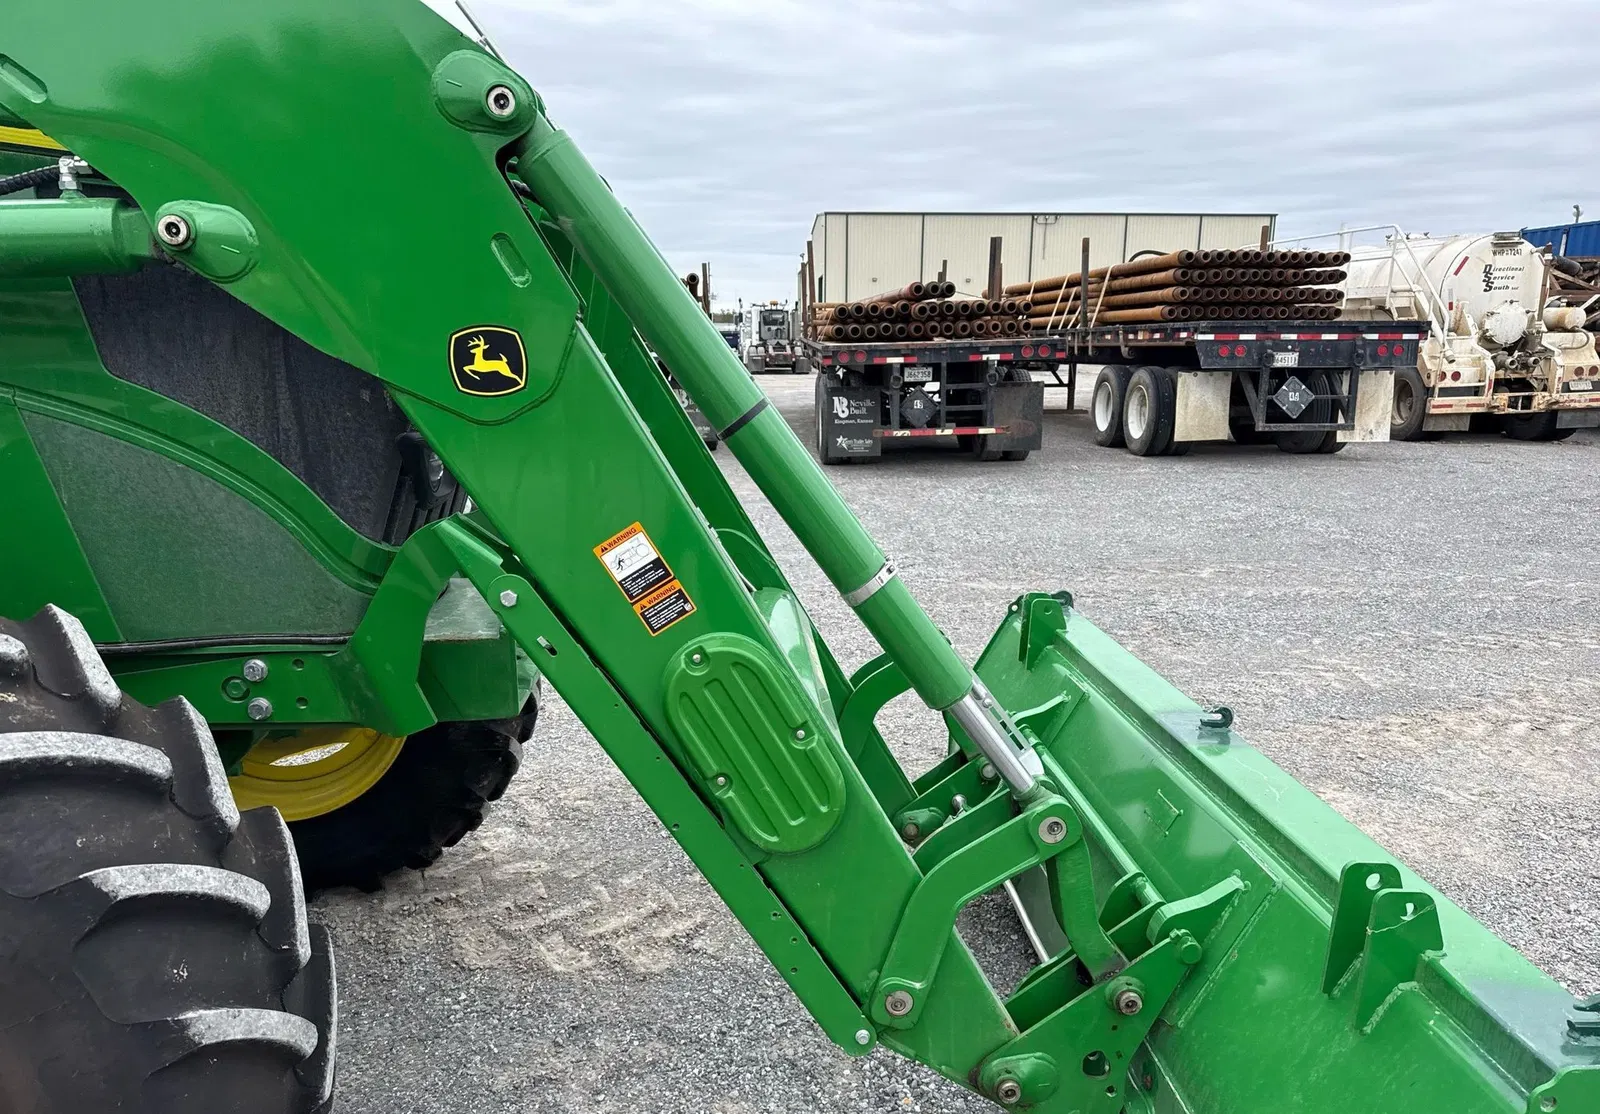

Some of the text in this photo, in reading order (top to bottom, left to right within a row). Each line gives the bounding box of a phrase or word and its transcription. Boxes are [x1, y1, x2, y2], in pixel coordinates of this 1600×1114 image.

[1483, 264, 1525, 274] Directional
[1482, 272, 1515, 282] Service
[1483, 281, 1510, 292] South
[850, 399, 876, 407] Neville
[607, 527, 637, 548] WARNING
[647, 585, 676, 605] WARNING
